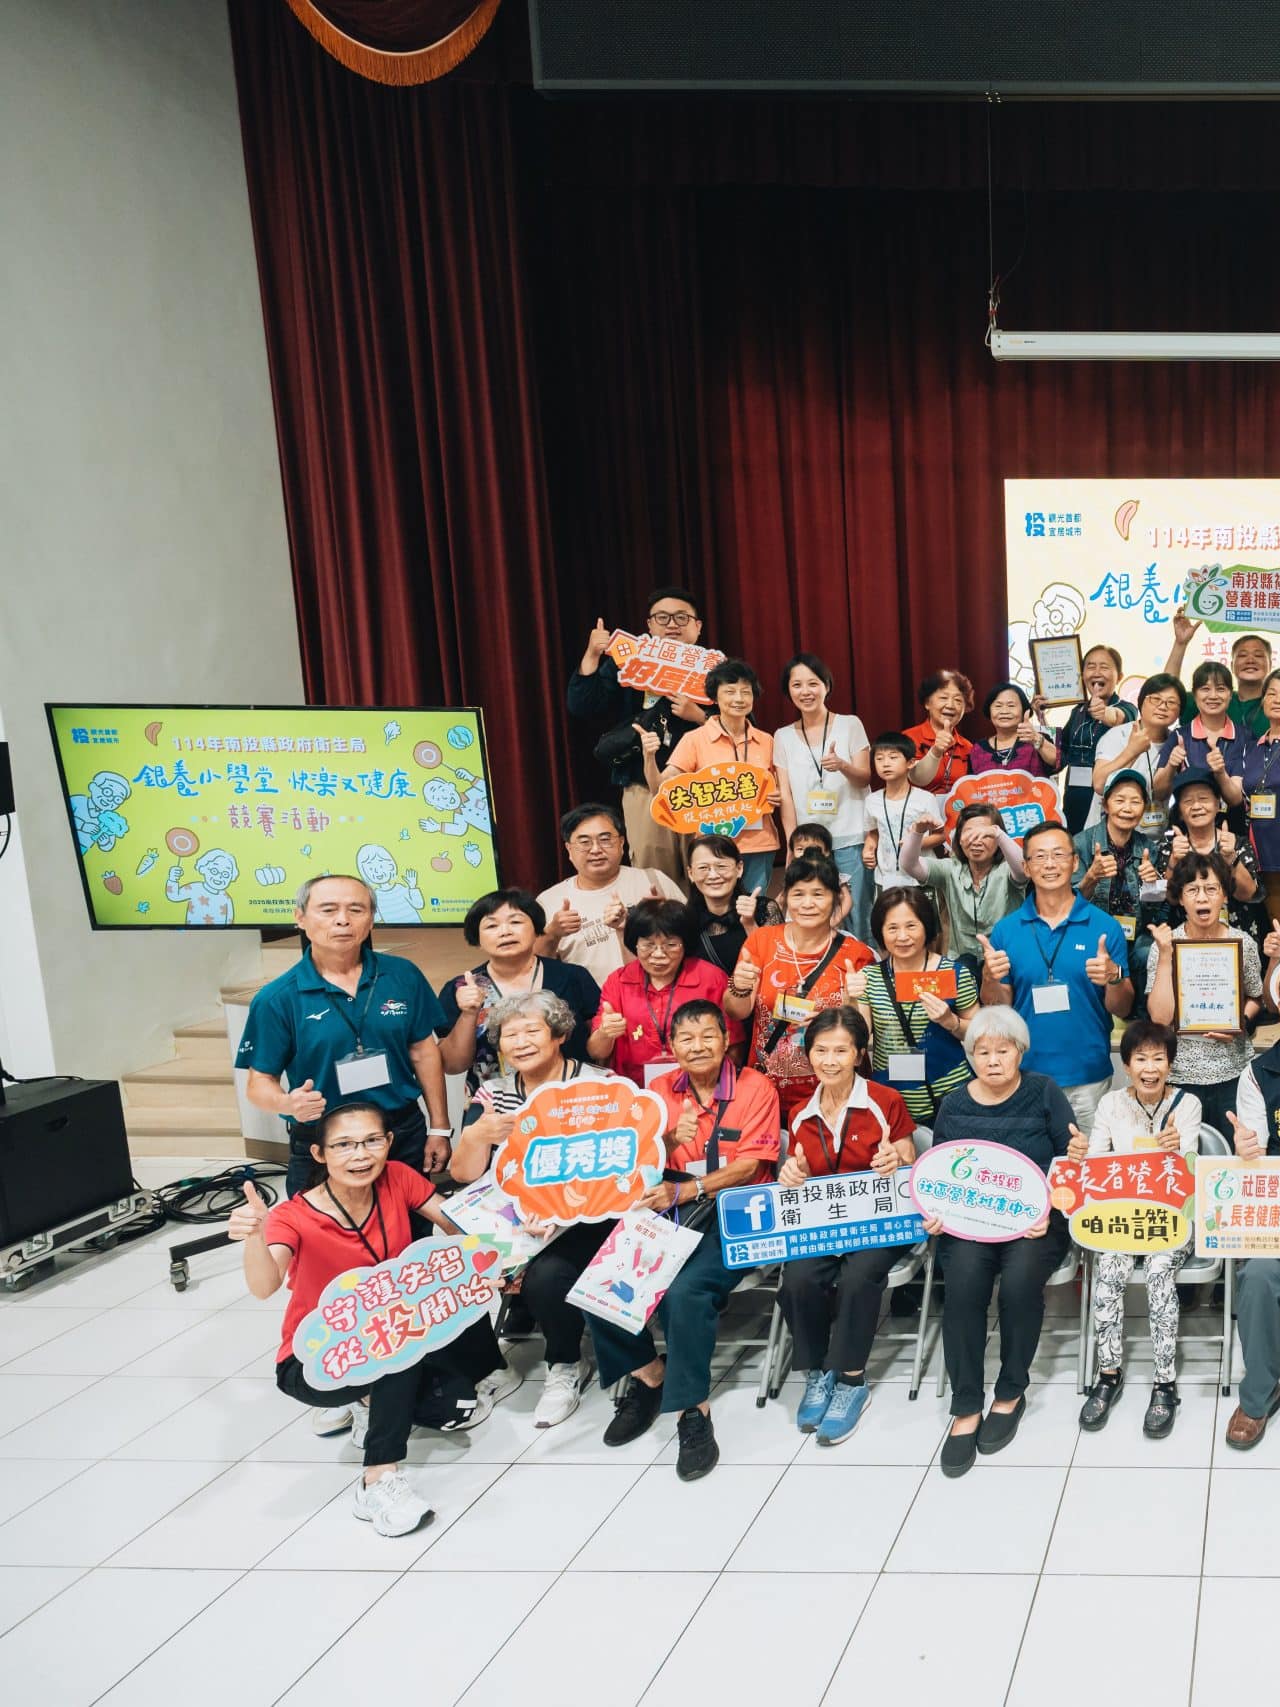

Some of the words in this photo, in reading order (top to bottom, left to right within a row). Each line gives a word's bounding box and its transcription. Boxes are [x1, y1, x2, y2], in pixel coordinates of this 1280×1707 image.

[637, 637, 724, 671] 社區營養
[133, 759, 280, 797] 銀養小學堂
[669, 772, 758, 811] 失智友善
[227, 803, 331, 838] 競賽活動
[529, 1135, 632, 1179] 優秀獎
[1077, 1155, 1187, 1197] 長者營養
[778, 1177, 892, 1207] 南投縣政府
[976, 1168, 1022, 1191] 南投縣
[729, 1244, 749, 1263] 投
[322, 1245, 465, 1332] 守護失智
[322, 1274, 495, 1379] 從投開始
